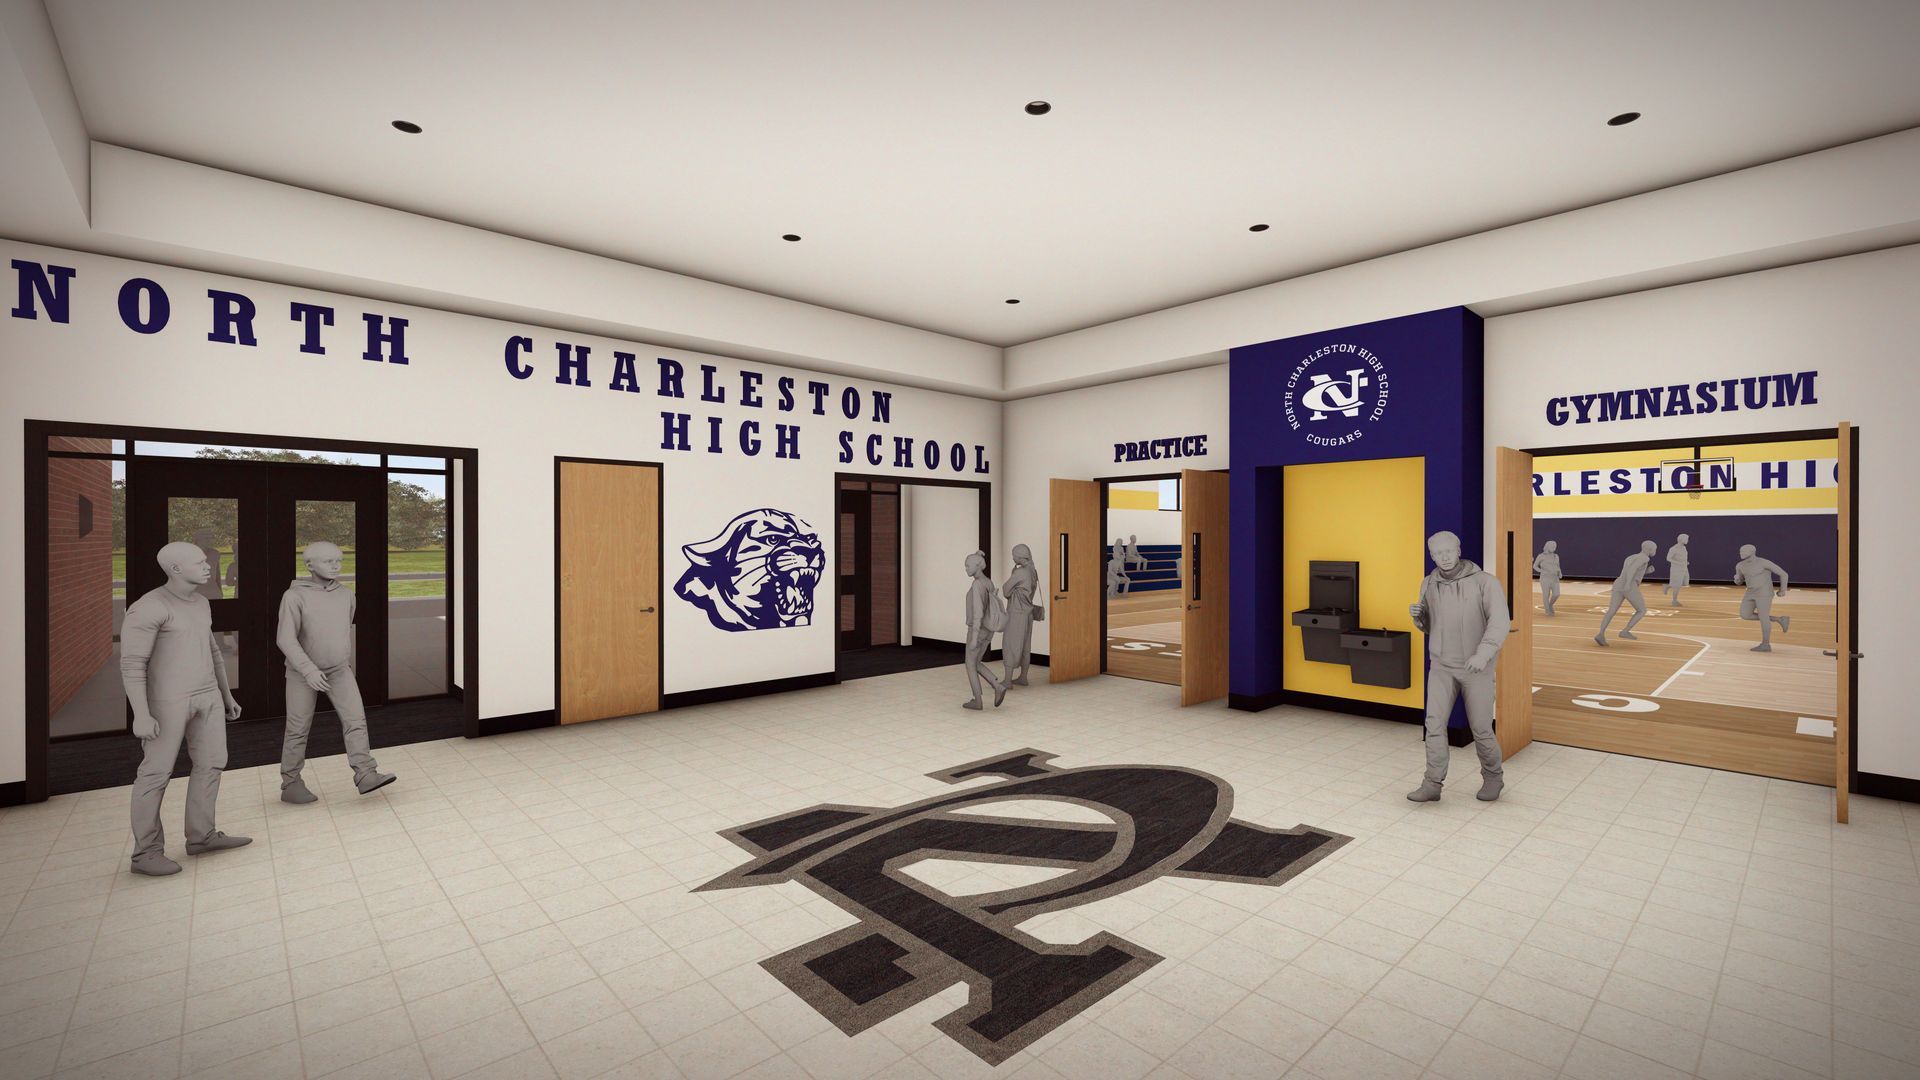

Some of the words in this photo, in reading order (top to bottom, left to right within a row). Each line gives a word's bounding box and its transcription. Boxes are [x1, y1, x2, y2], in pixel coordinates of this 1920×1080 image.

[11, 259, 410, 366] NORTH
[504, 335, 893, 424] CHARLESTON
[1357, 347, 1384, 373] HIGH
[1287, 343, 1357, 389] CHARLESTON
[1284, 391, 1301, 431] NORTH
[1369, 373, 1389, 422] SCHOOL
[1546, 371, 1818, 426] GYMNASIUM
[660, 411, 801, 460] HIGH
[838, 430, 991, 474] SCHOOL
[1114, 434, 1208, 463] PRACTICE
[1306, 429, 1363, 447] COUGARS
[1761, 459, 1838, 490] HI
